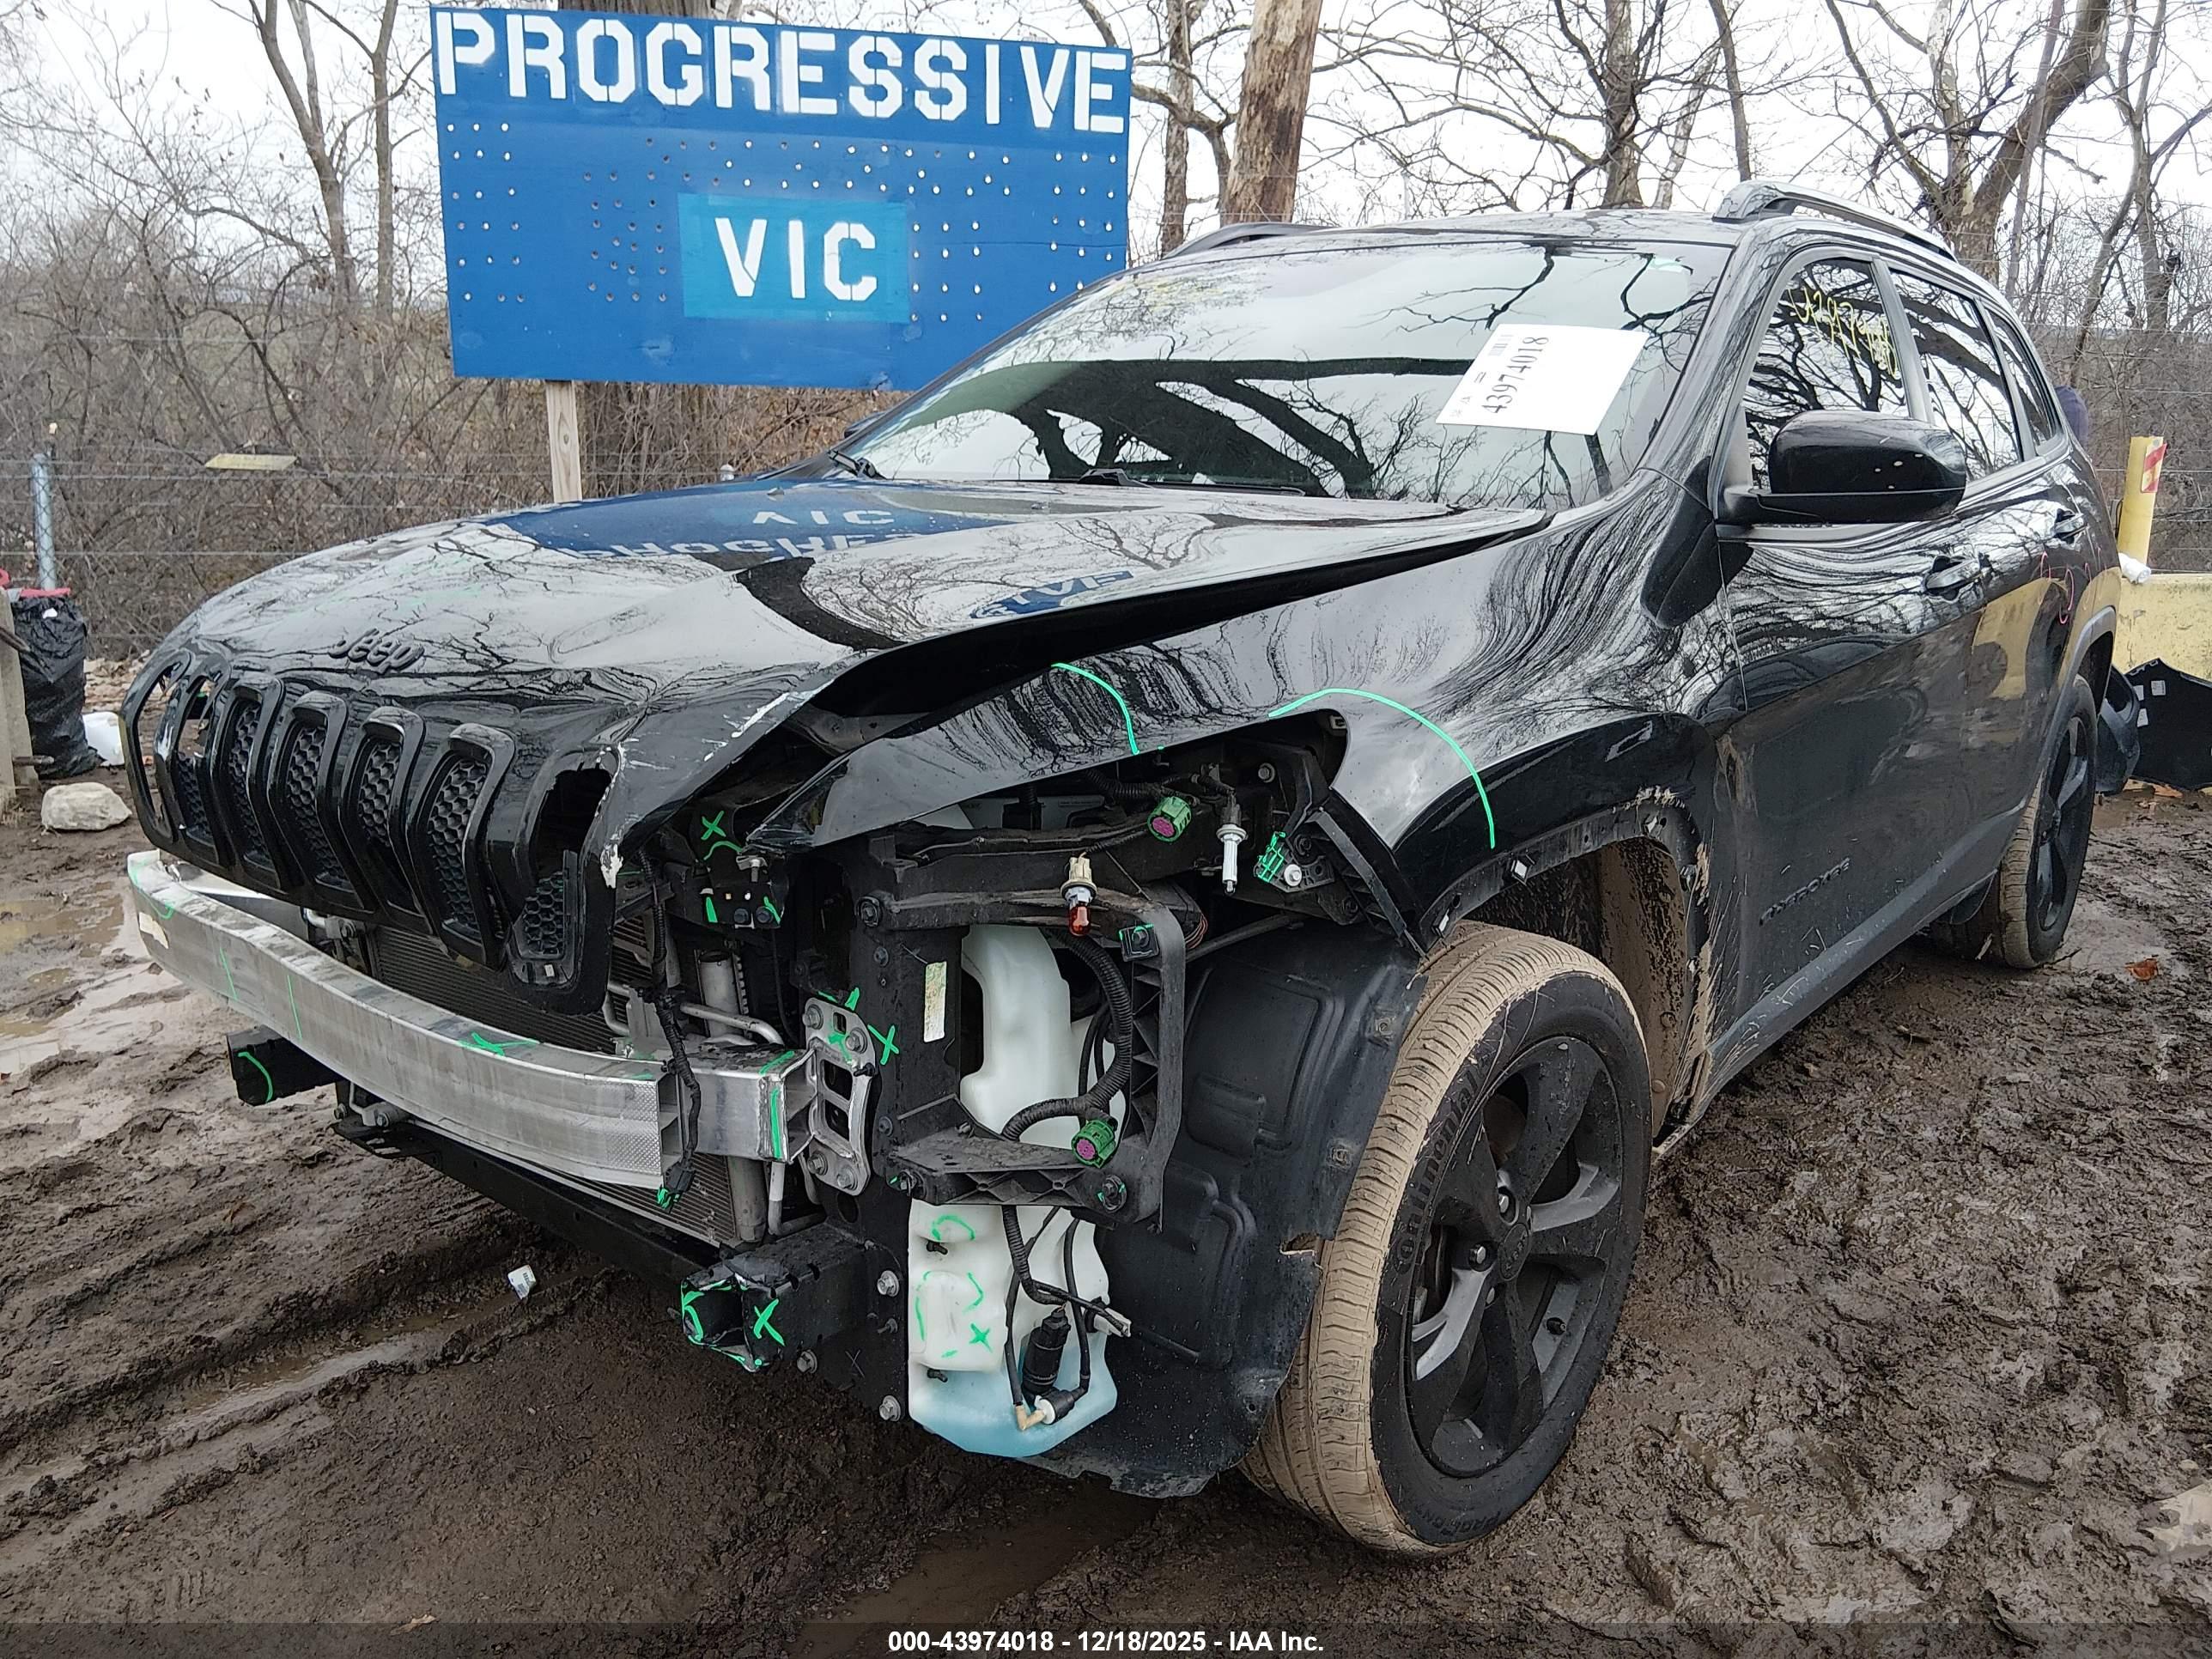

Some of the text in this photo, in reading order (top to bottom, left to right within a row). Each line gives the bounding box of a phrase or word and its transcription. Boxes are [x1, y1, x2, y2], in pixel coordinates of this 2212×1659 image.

[438, 12, 1127, 133] PROGRESSIVE
[715, 218, 878, 301] VIC
[1482, 337, 1549, 413] 43974018
[327, 628, 424, 675] Jeep
